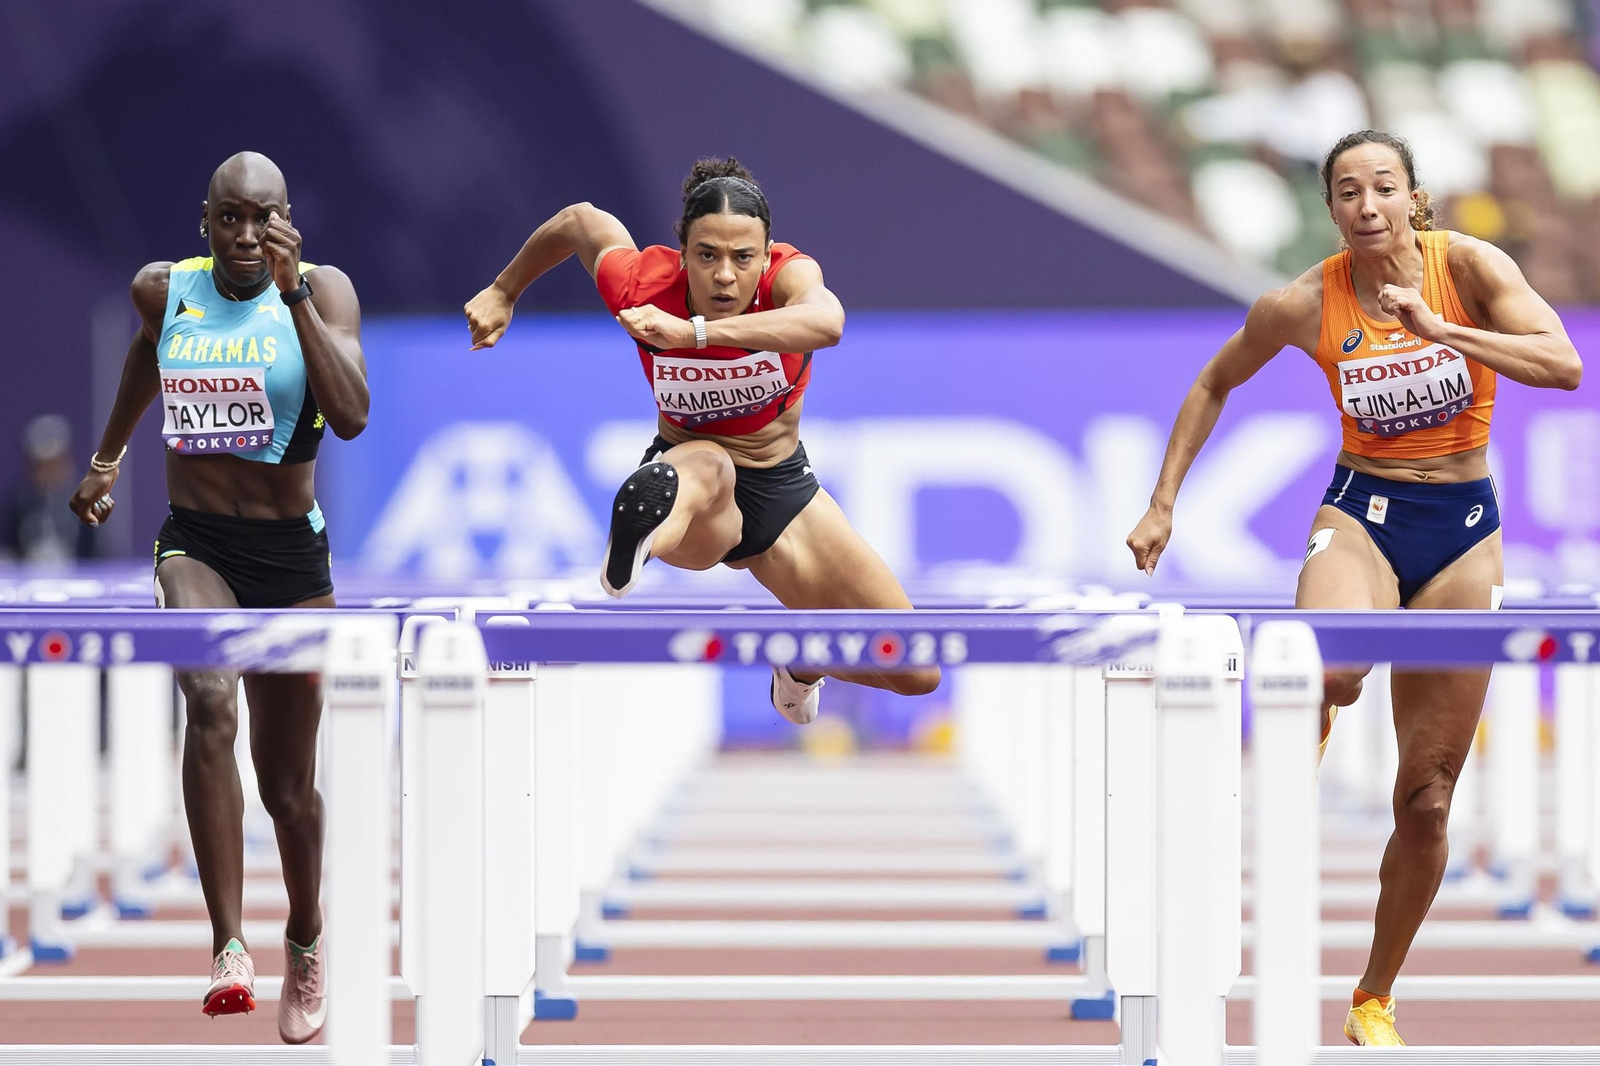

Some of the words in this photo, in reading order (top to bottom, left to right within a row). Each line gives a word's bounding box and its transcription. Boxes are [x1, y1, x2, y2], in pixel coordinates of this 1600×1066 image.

[167, 334, 277, 363] BAHAMAS
[1369, 337, 1422, 351] Staatsloterij
[655, 359, 780, 382] HONDA
[1343, 348, 1460, 386] HONDA
[162, 377, 263, 394] HONDA
[660, 380, 783, 412] KAMBUNDJI
[1348, 372, 1467, 418] TJIN-A-LIM
[168, 402, 266, 430] TAYLOR
